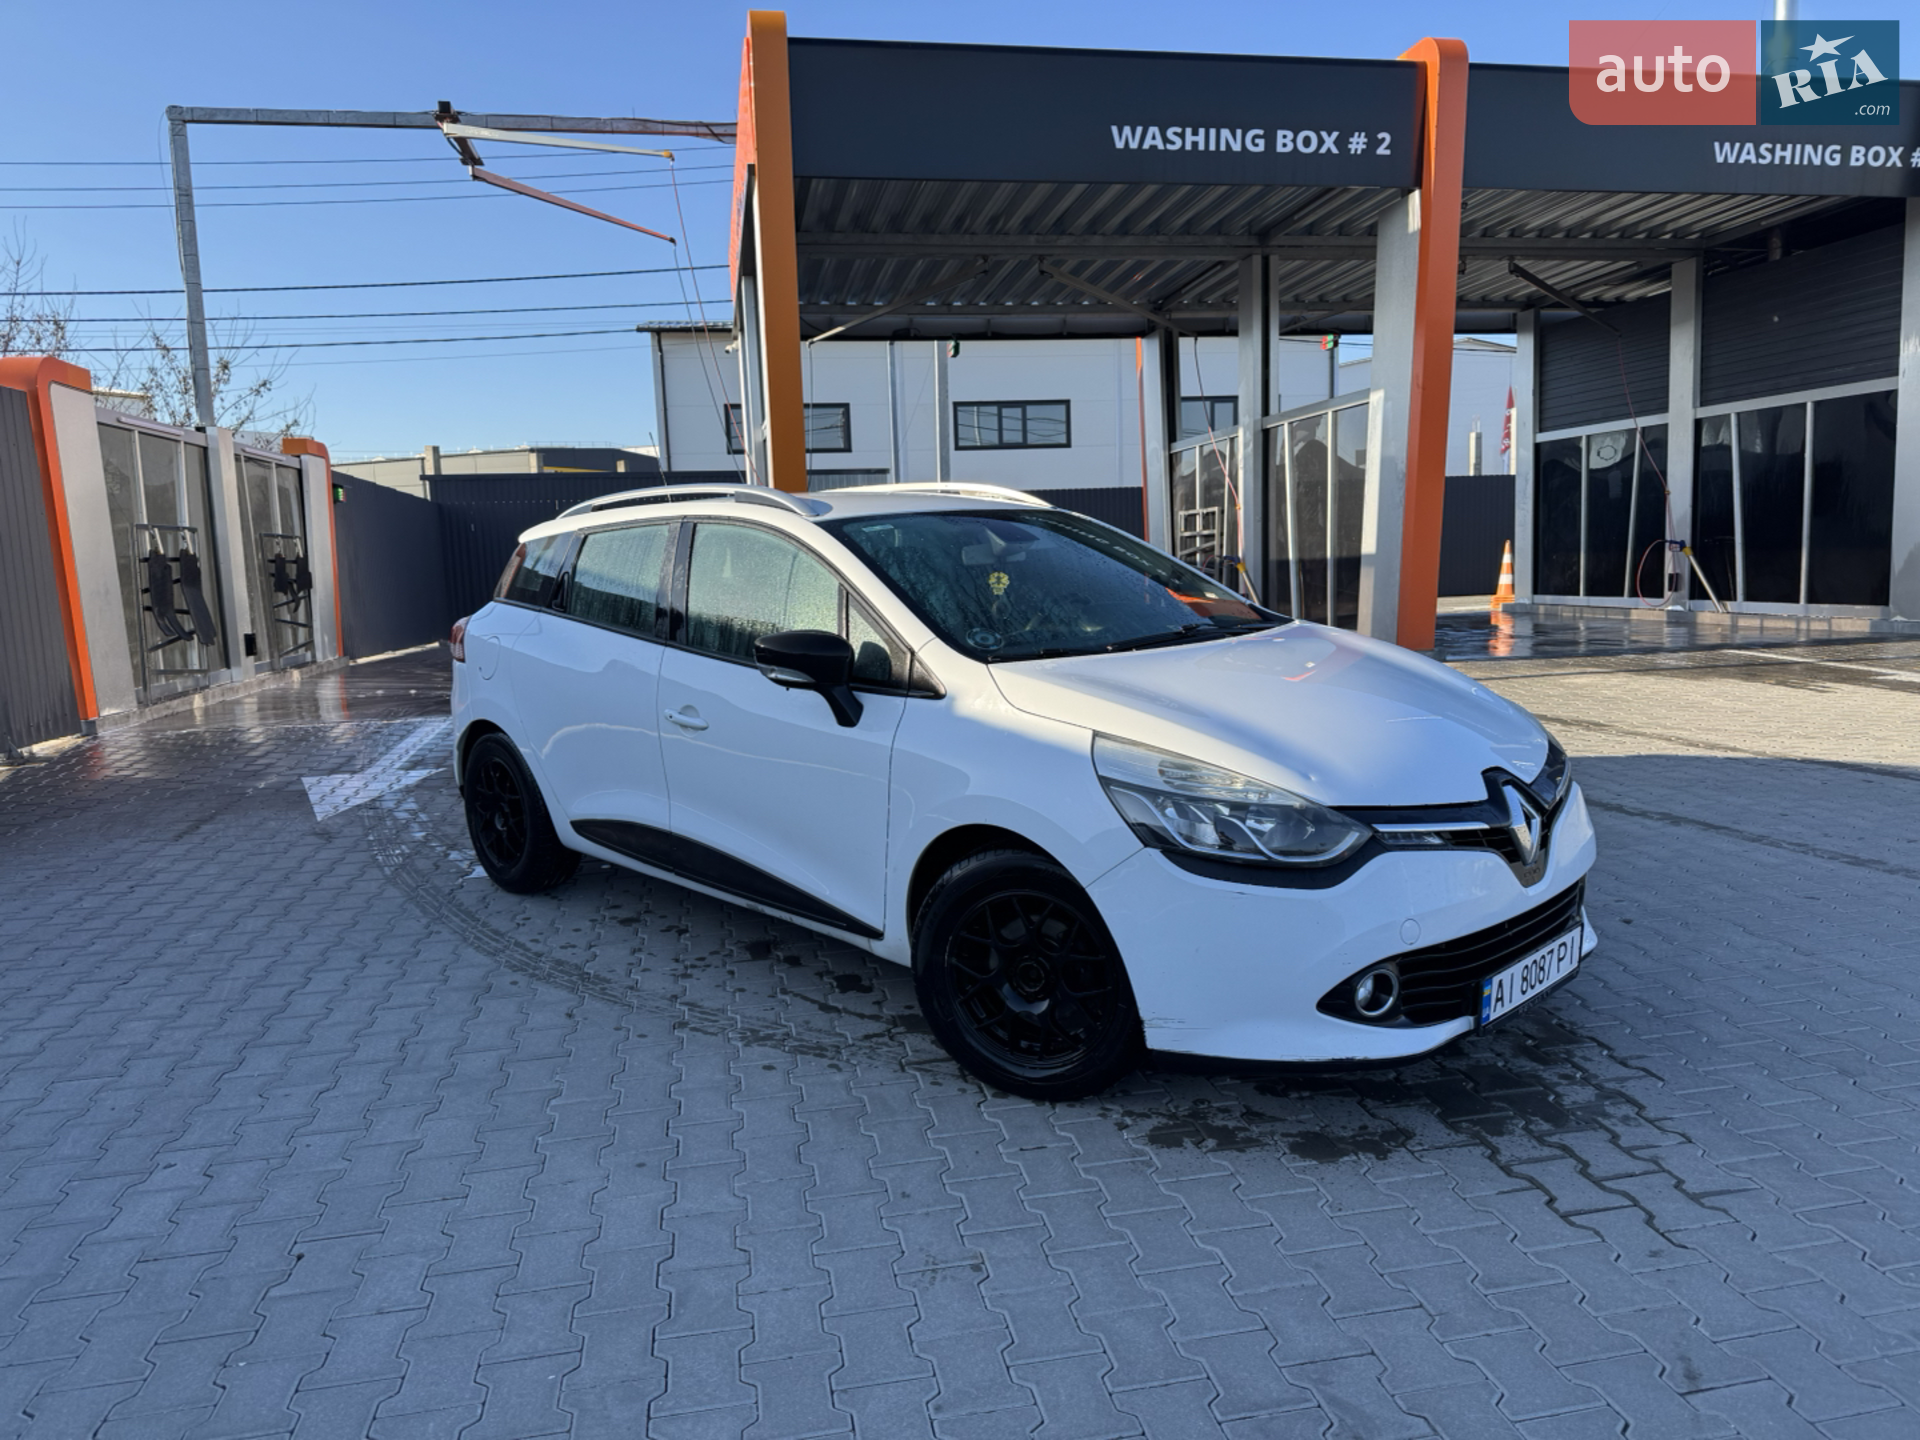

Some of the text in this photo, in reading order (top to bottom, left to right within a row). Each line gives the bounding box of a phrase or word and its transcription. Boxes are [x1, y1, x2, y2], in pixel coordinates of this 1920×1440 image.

[1110, 125, 1393, 156] WASHING BOX # 2
[1713, 141, 1842, 167] WASHING
[1849, 145, 1905, 168] BOX
[1493, 972, 1514, 1013] AI
[1520, 947, 1555, 996] 8087
[1557, 935, 1575, 974] PI
